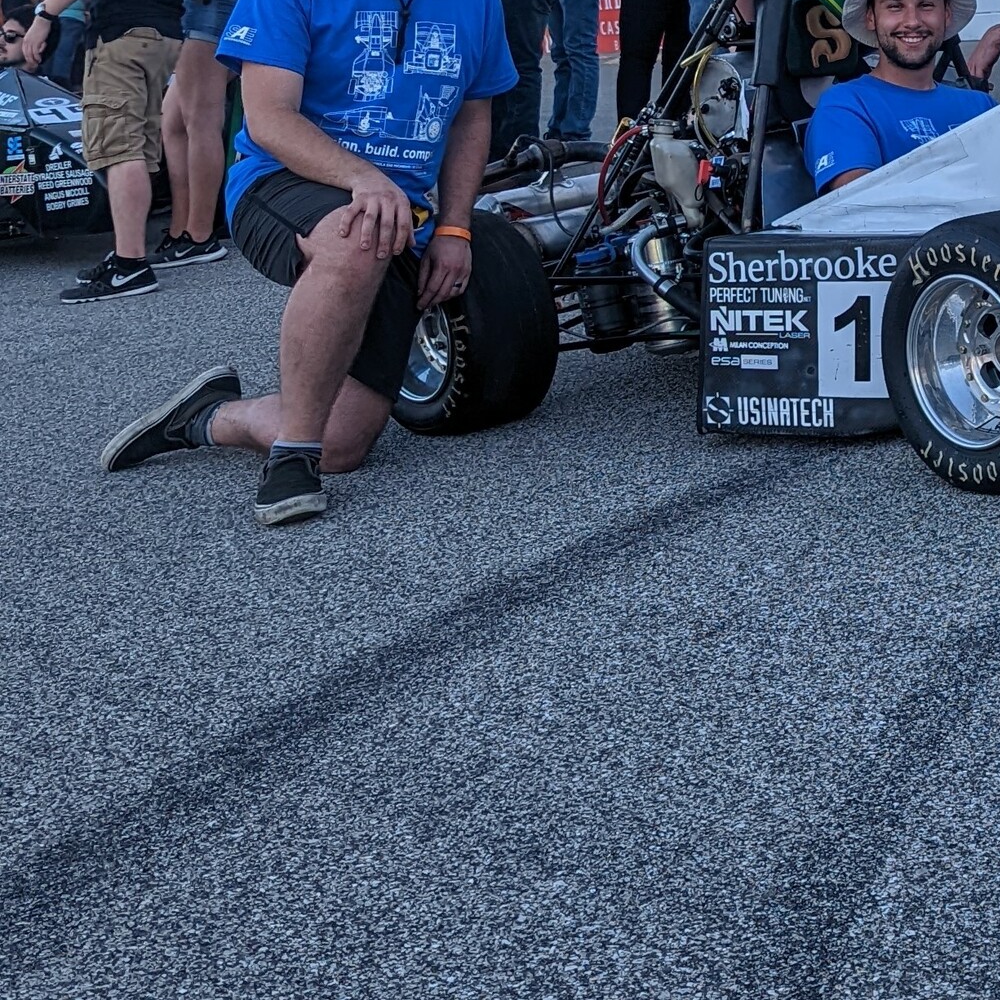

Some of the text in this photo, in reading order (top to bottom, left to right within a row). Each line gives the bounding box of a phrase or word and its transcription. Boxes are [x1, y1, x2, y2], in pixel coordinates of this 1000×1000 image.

[601, 21, 620, 36] CAS
[365, 143, 400, 158] build.
[403, 149, 433, 162] comp
[45, 161, 72, 172] DREXLER
[55, 177, 93, 188] GREENWOOD
[1, 185, 35, 195] BATTERIES
[44, 191, 65, 201] ANGUS
[46, 201, 66, 212] BOBBY
[708, 246, 897, 284] Sherbrooke
[709, 287, 758, 303] PERFECT
[710, 305, 810, 336] NITEK
[711, 356, 740, 366] esa
[737, 396, 835, 428] USINATECH
